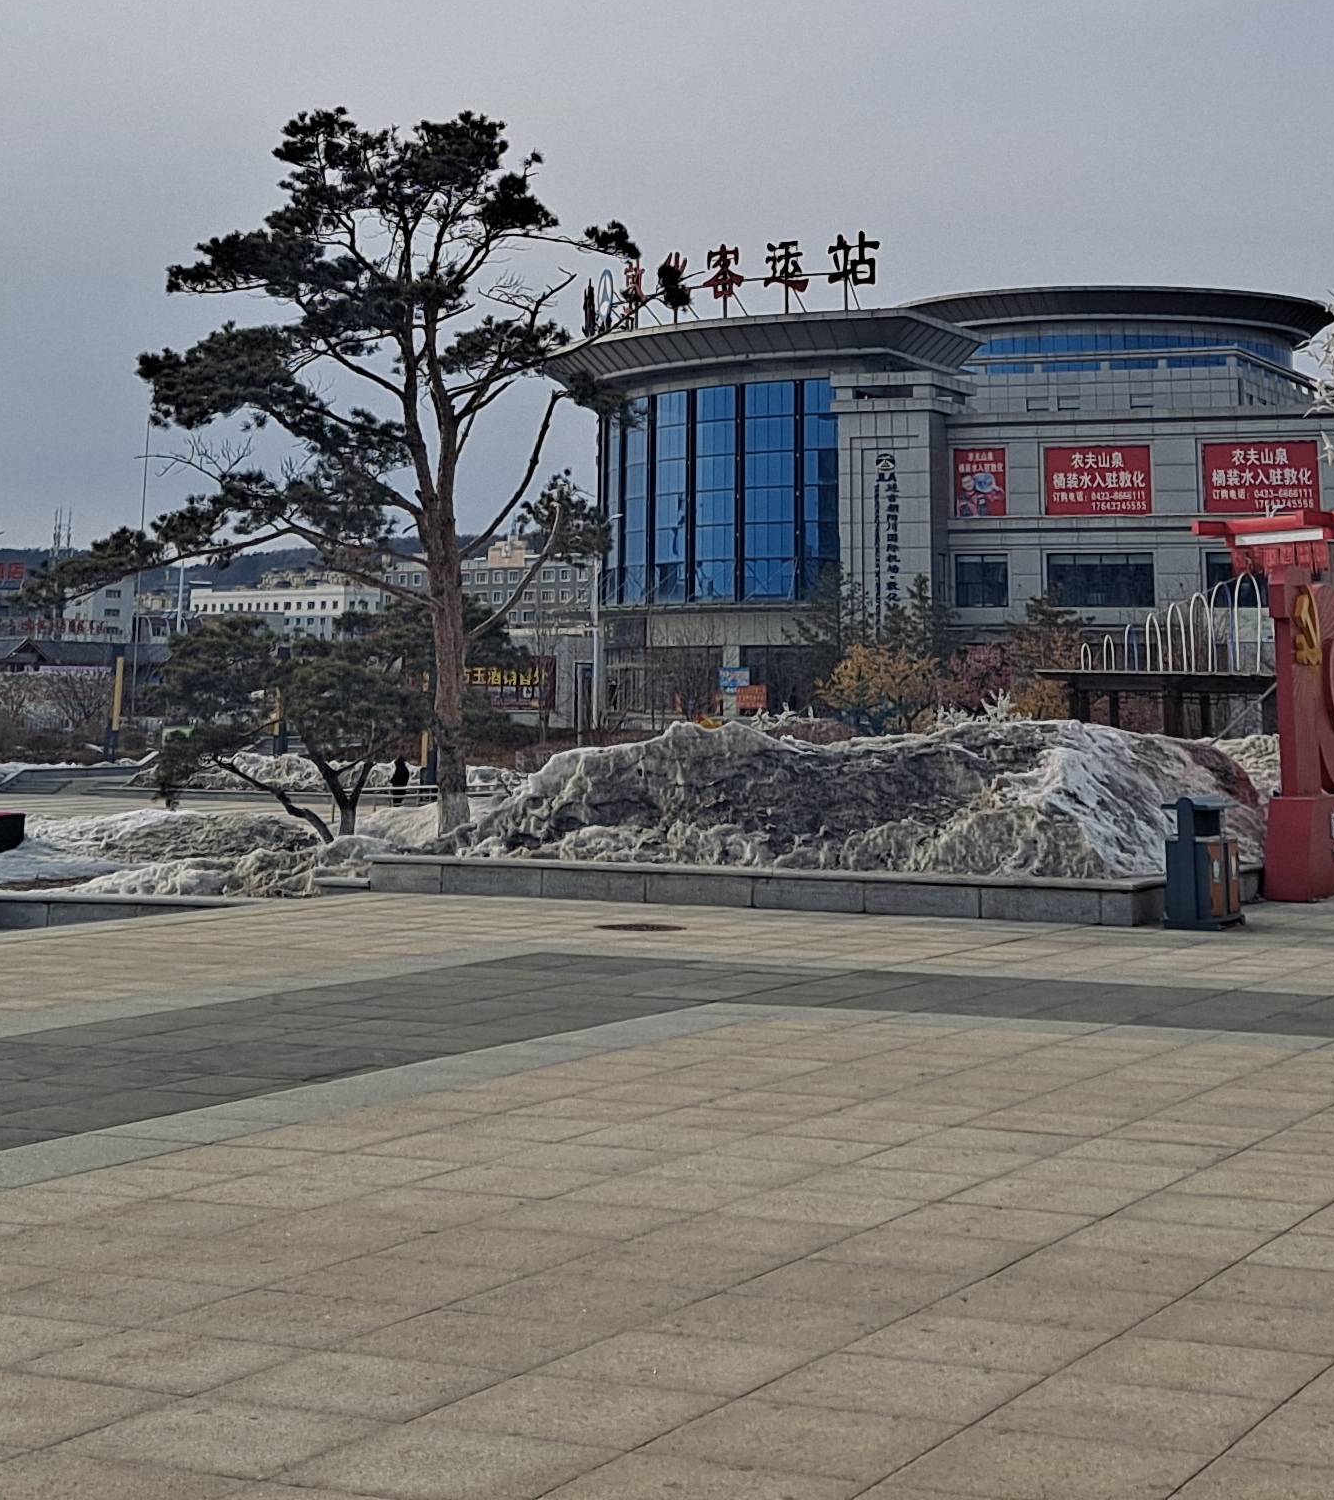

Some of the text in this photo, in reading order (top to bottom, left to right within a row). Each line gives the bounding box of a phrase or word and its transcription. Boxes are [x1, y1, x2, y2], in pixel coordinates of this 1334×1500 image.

[1071, 452, 1123, 468] 农夫山泉
[1231, 448, 1288, 465] 农夫山泉
[1053, 471, 1145, 489] 桶装水入驻敦化
[1212, 468, 1312, 486] 桶装水入驻敦化
